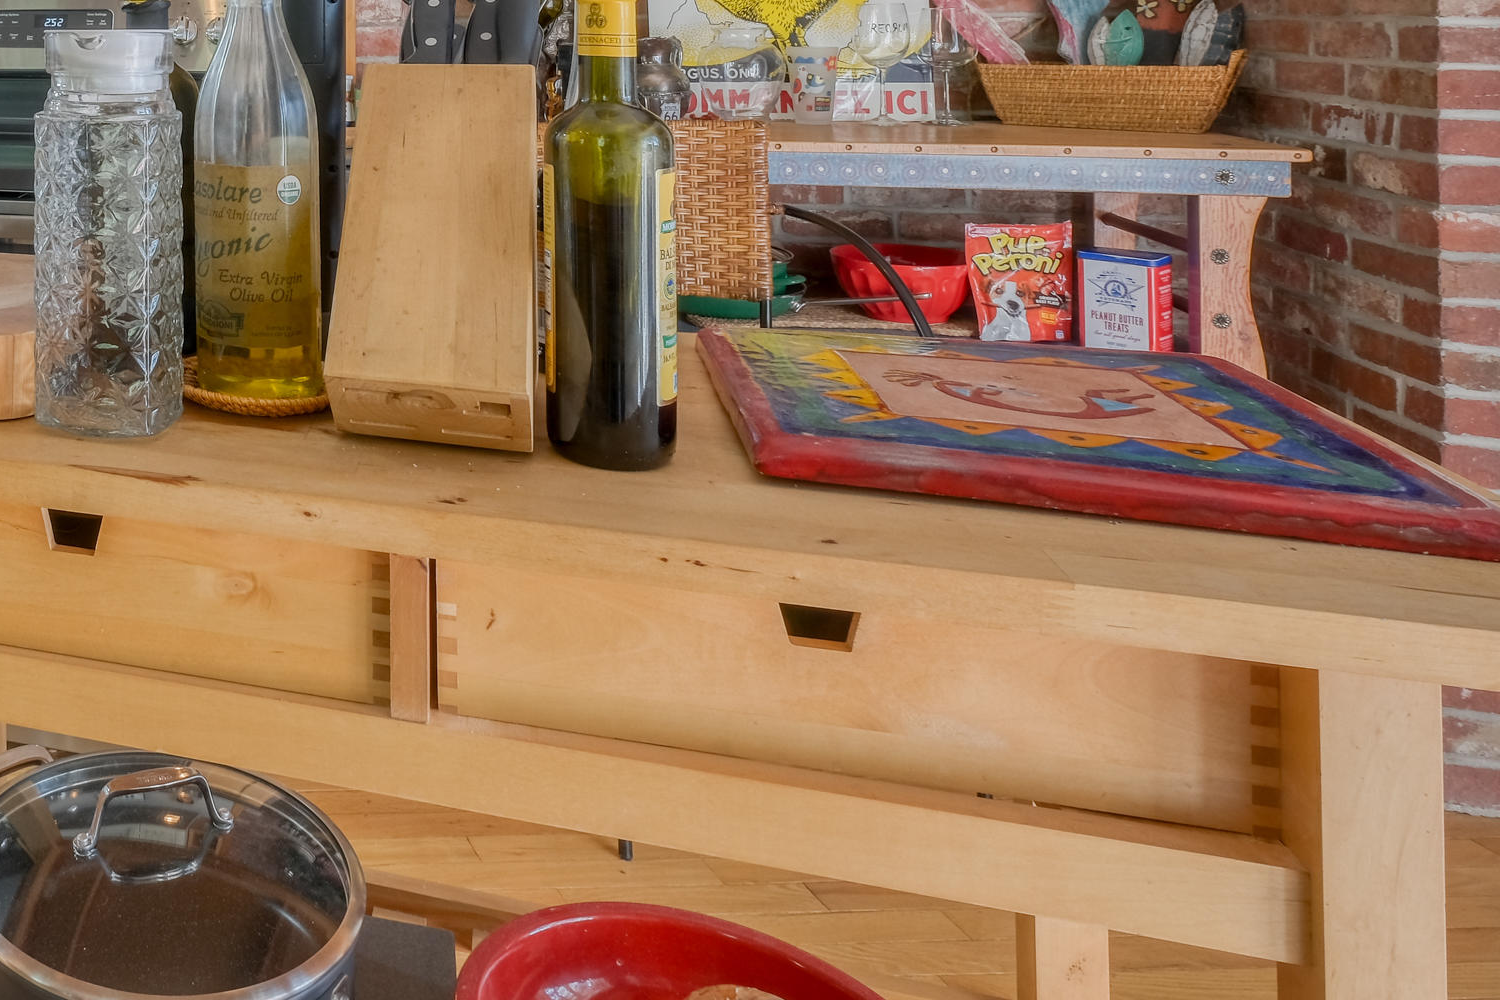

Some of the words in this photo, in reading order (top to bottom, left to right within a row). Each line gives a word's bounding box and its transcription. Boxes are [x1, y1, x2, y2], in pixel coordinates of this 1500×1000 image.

[884, 90, 929, 116] ICI
[664, 111, 678, 121] 66
[226, 208, 280, 225] Unfiltered
[972, 252, 1064, 276] Peroni
[218, 269, 254, 286] Extra
[260, 270, 303, 286] Virgin
[229, 287, 265, 303] Olive
[270, 288, 294, 304] Oil
[1090, 310, 1117, 322] PEANUT
[1118, 314, 1144, 327] BUTTER
[1104, 321, 1130, 333] TREATS
